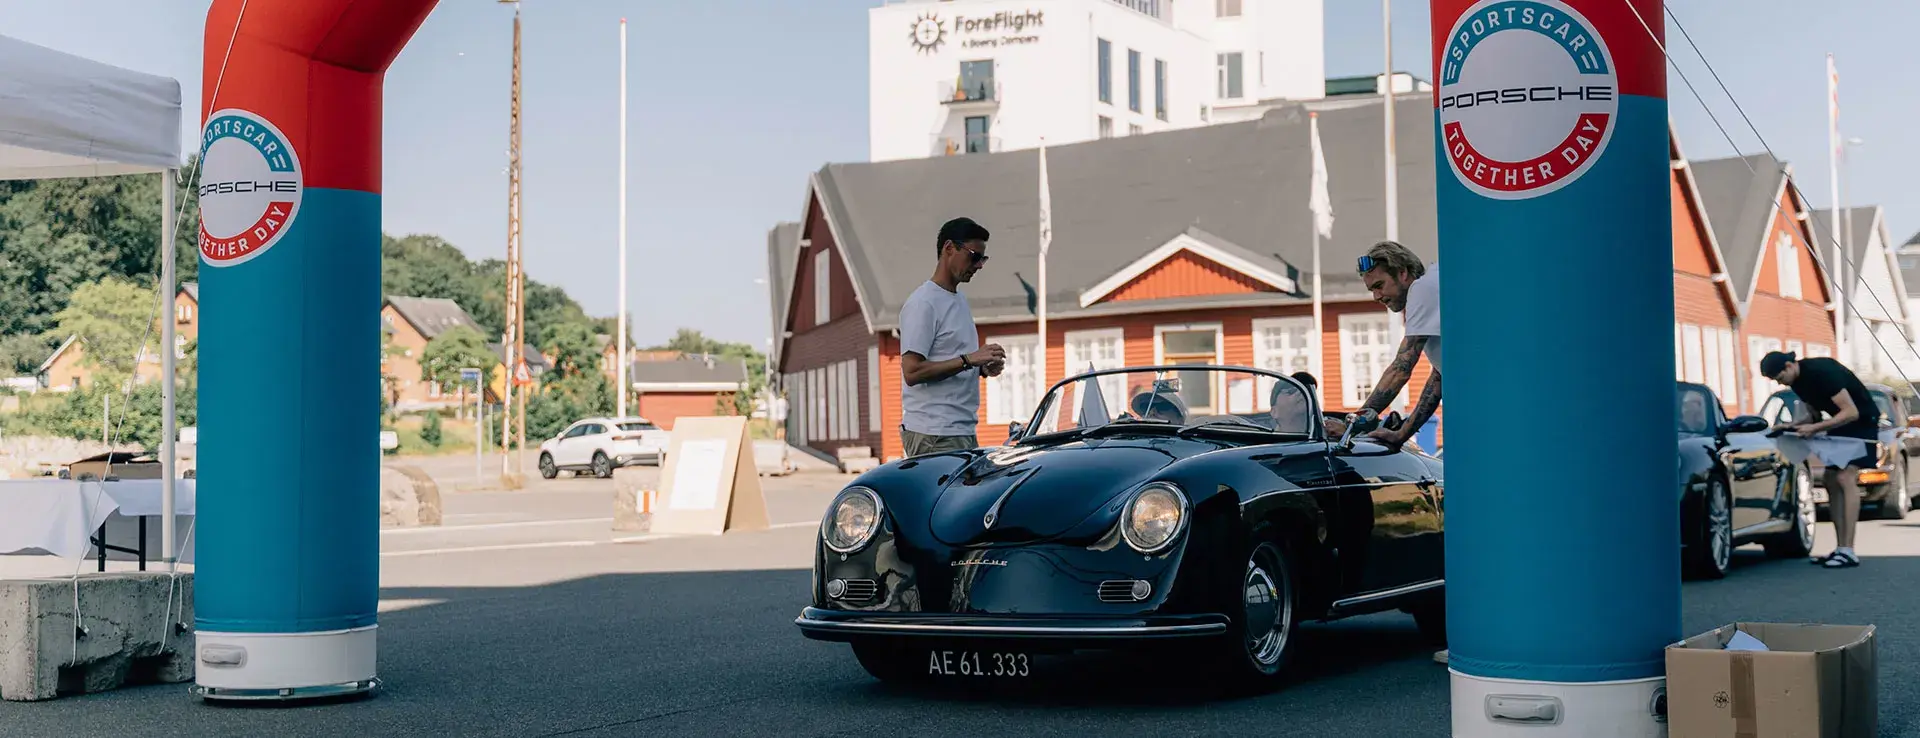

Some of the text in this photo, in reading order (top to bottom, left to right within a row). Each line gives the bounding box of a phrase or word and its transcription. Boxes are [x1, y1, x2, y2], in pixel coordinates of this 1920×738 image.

[955, 9, 1044, 32] ForeFlight
[1452, 7, 1587, 61] SPORTSCAR
[1442, 86, 1612, 112] PORSCHE
[1449, 119, 1600, 186] TOGETHER DAY
[200, 181, 297, 197] ORSCHE
[254, 205, 286, 241] DAY
[929, 650, 1029, 677] AE 61.333
